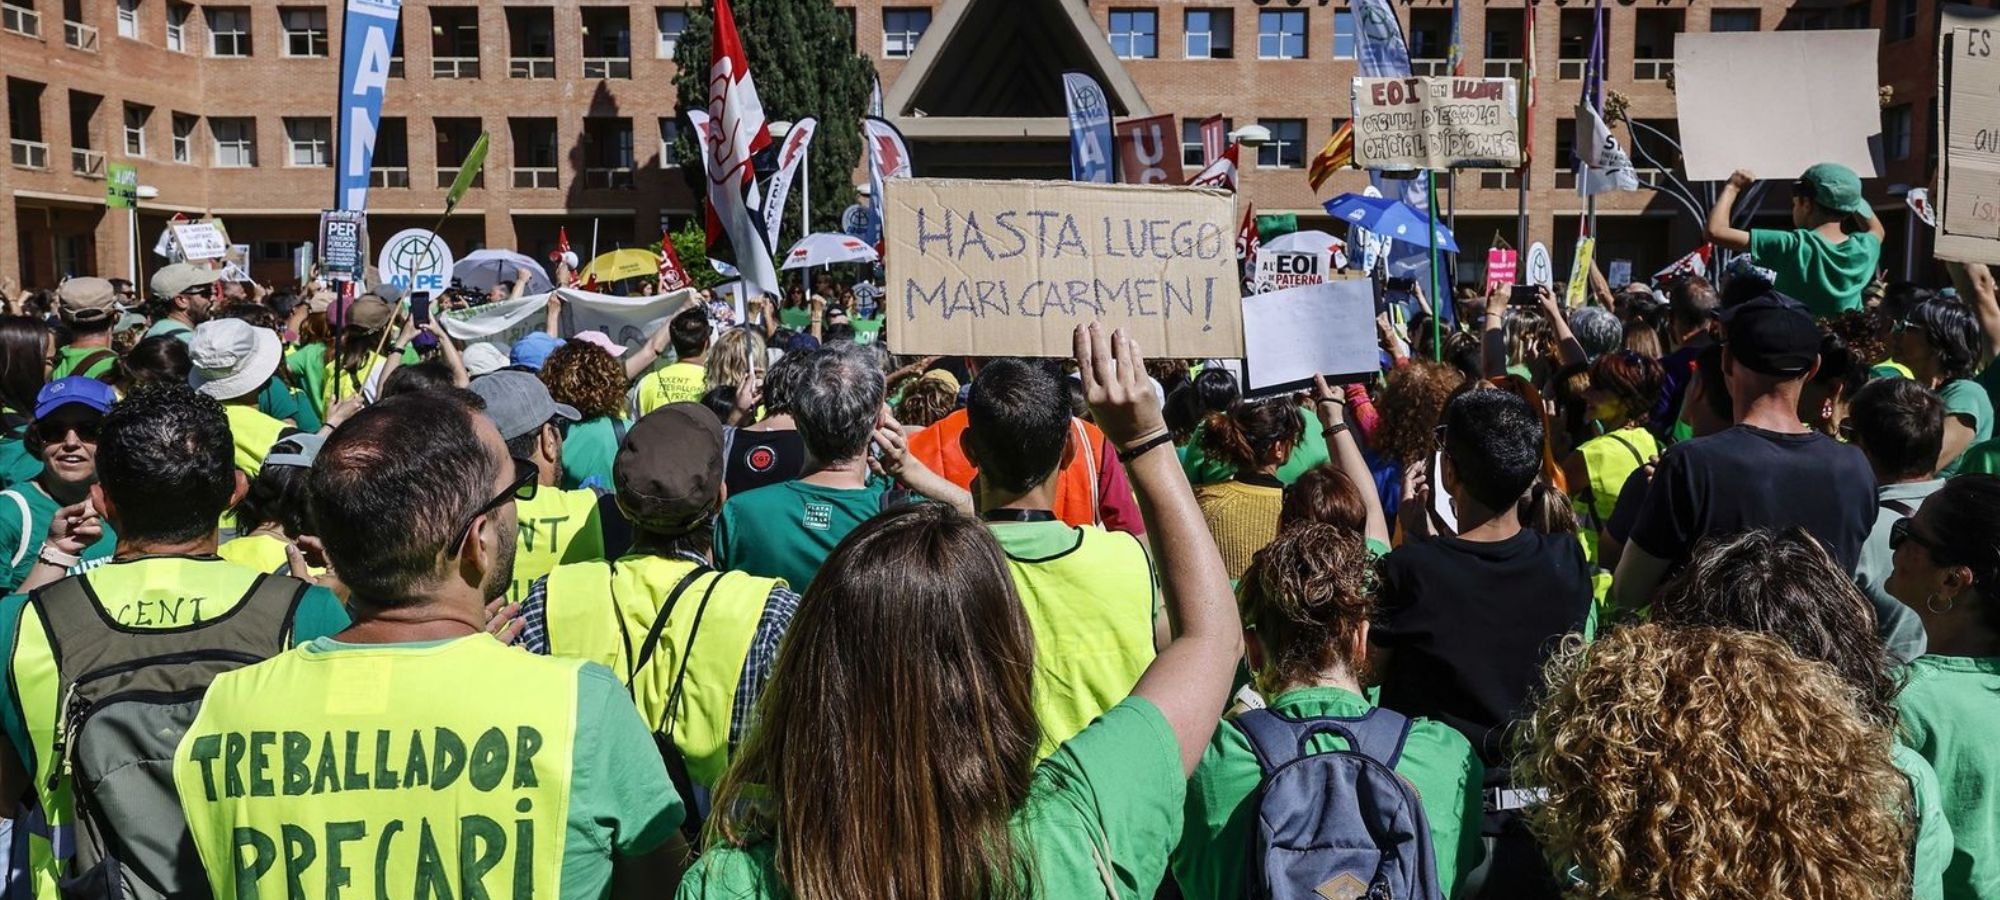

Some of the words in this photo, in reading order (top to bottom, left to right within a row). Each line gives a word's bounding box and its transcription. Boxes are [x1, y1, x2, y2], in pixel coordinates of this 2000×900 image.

[1371, 78, 1420, 106] EOI
[328, 222, 357, 237] PER
[917, 207, 1088, 261] HASTA
[1276, 274, 1323, 285] PATERNA
[906, 276, 1010, 321] MARI
[1017, 275, 1219, 332] CARMEN!
[188, 725, 544, 802] TREBALLADOR
